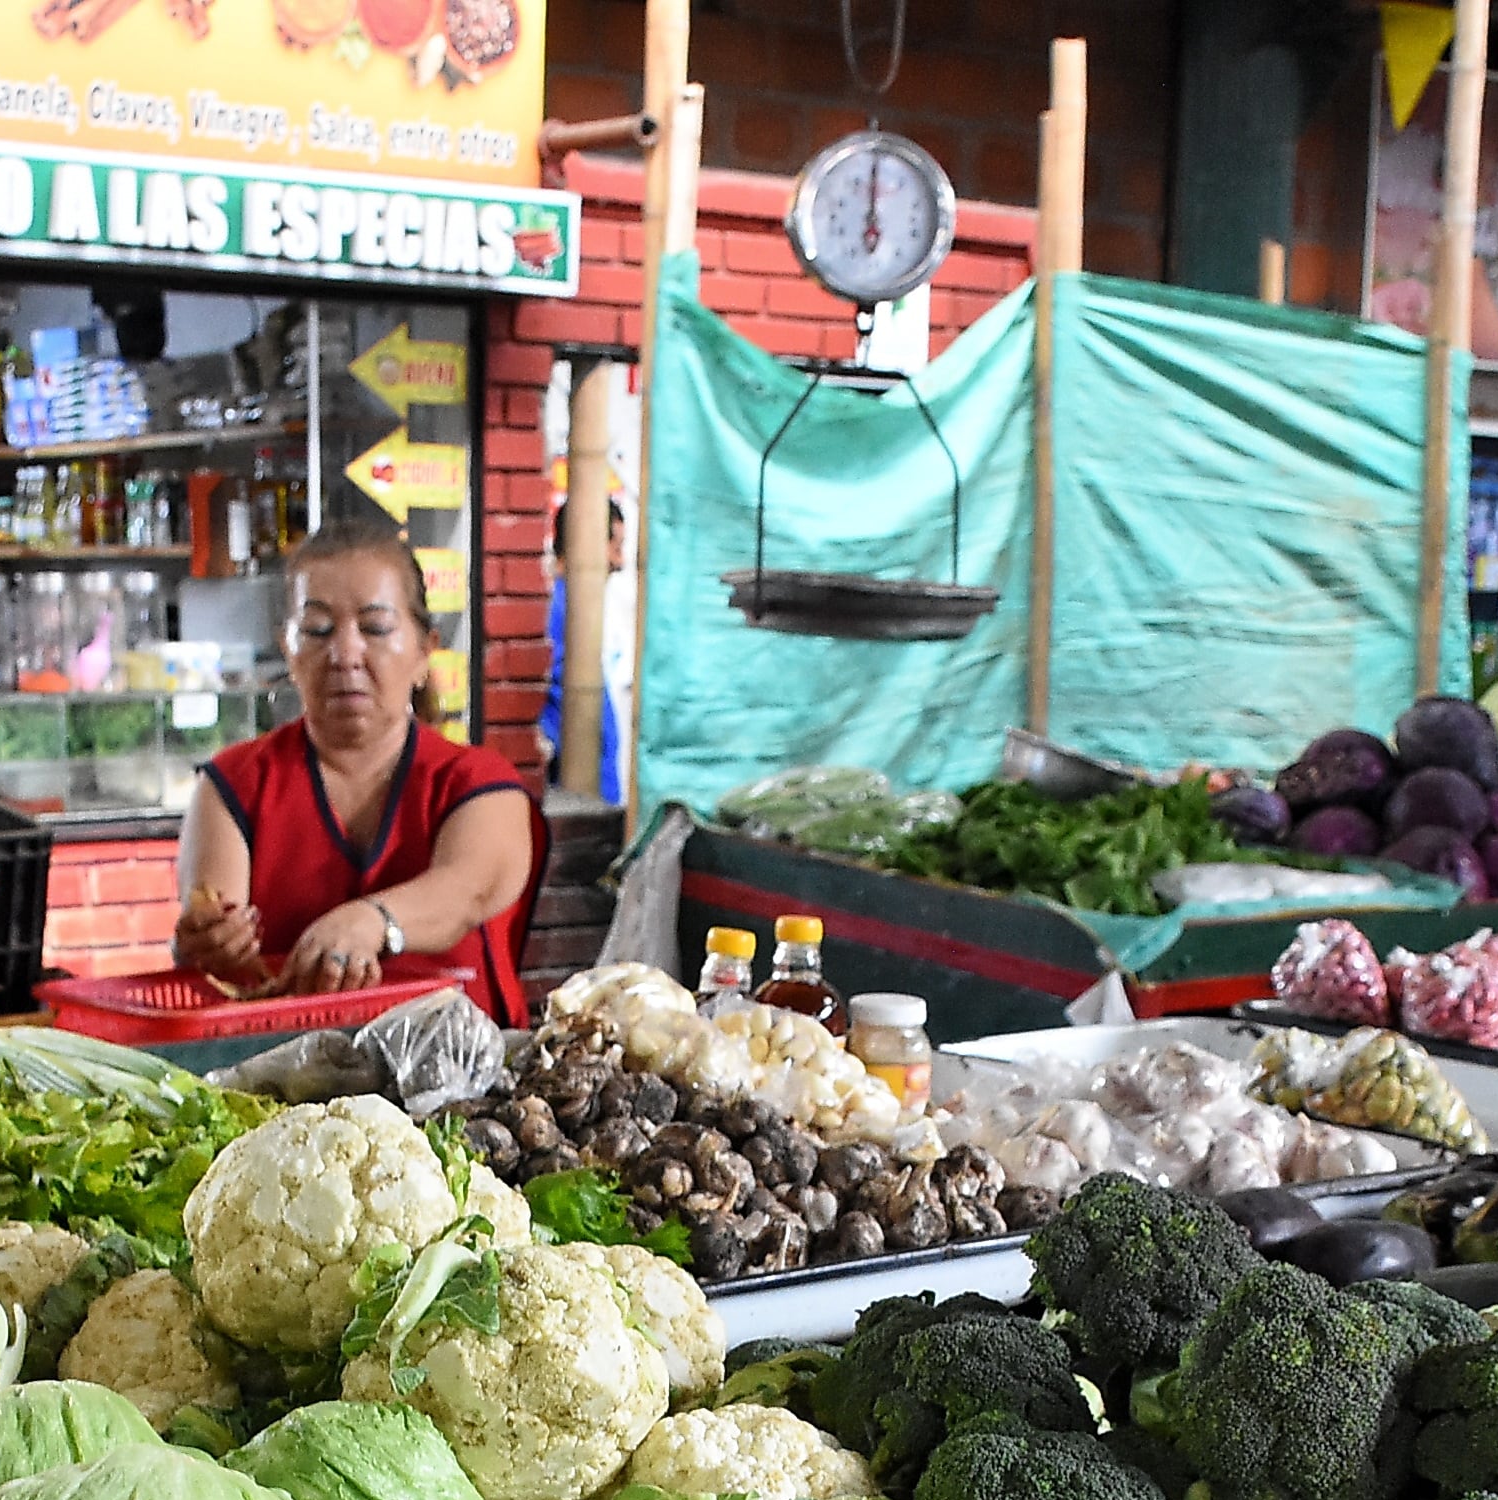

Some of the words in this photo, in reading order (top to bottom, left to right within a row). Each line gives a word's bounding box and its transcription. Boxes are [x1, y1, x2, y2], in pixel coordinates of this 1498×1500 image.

[90, 84, 179, 137] Clavos,
[309, 106, 379, 160] Salsa,
[48, 162, 101, 241] A
[107, 167, 229, 254] LAS
[243, 178, 515, 278] ESPECIAS
